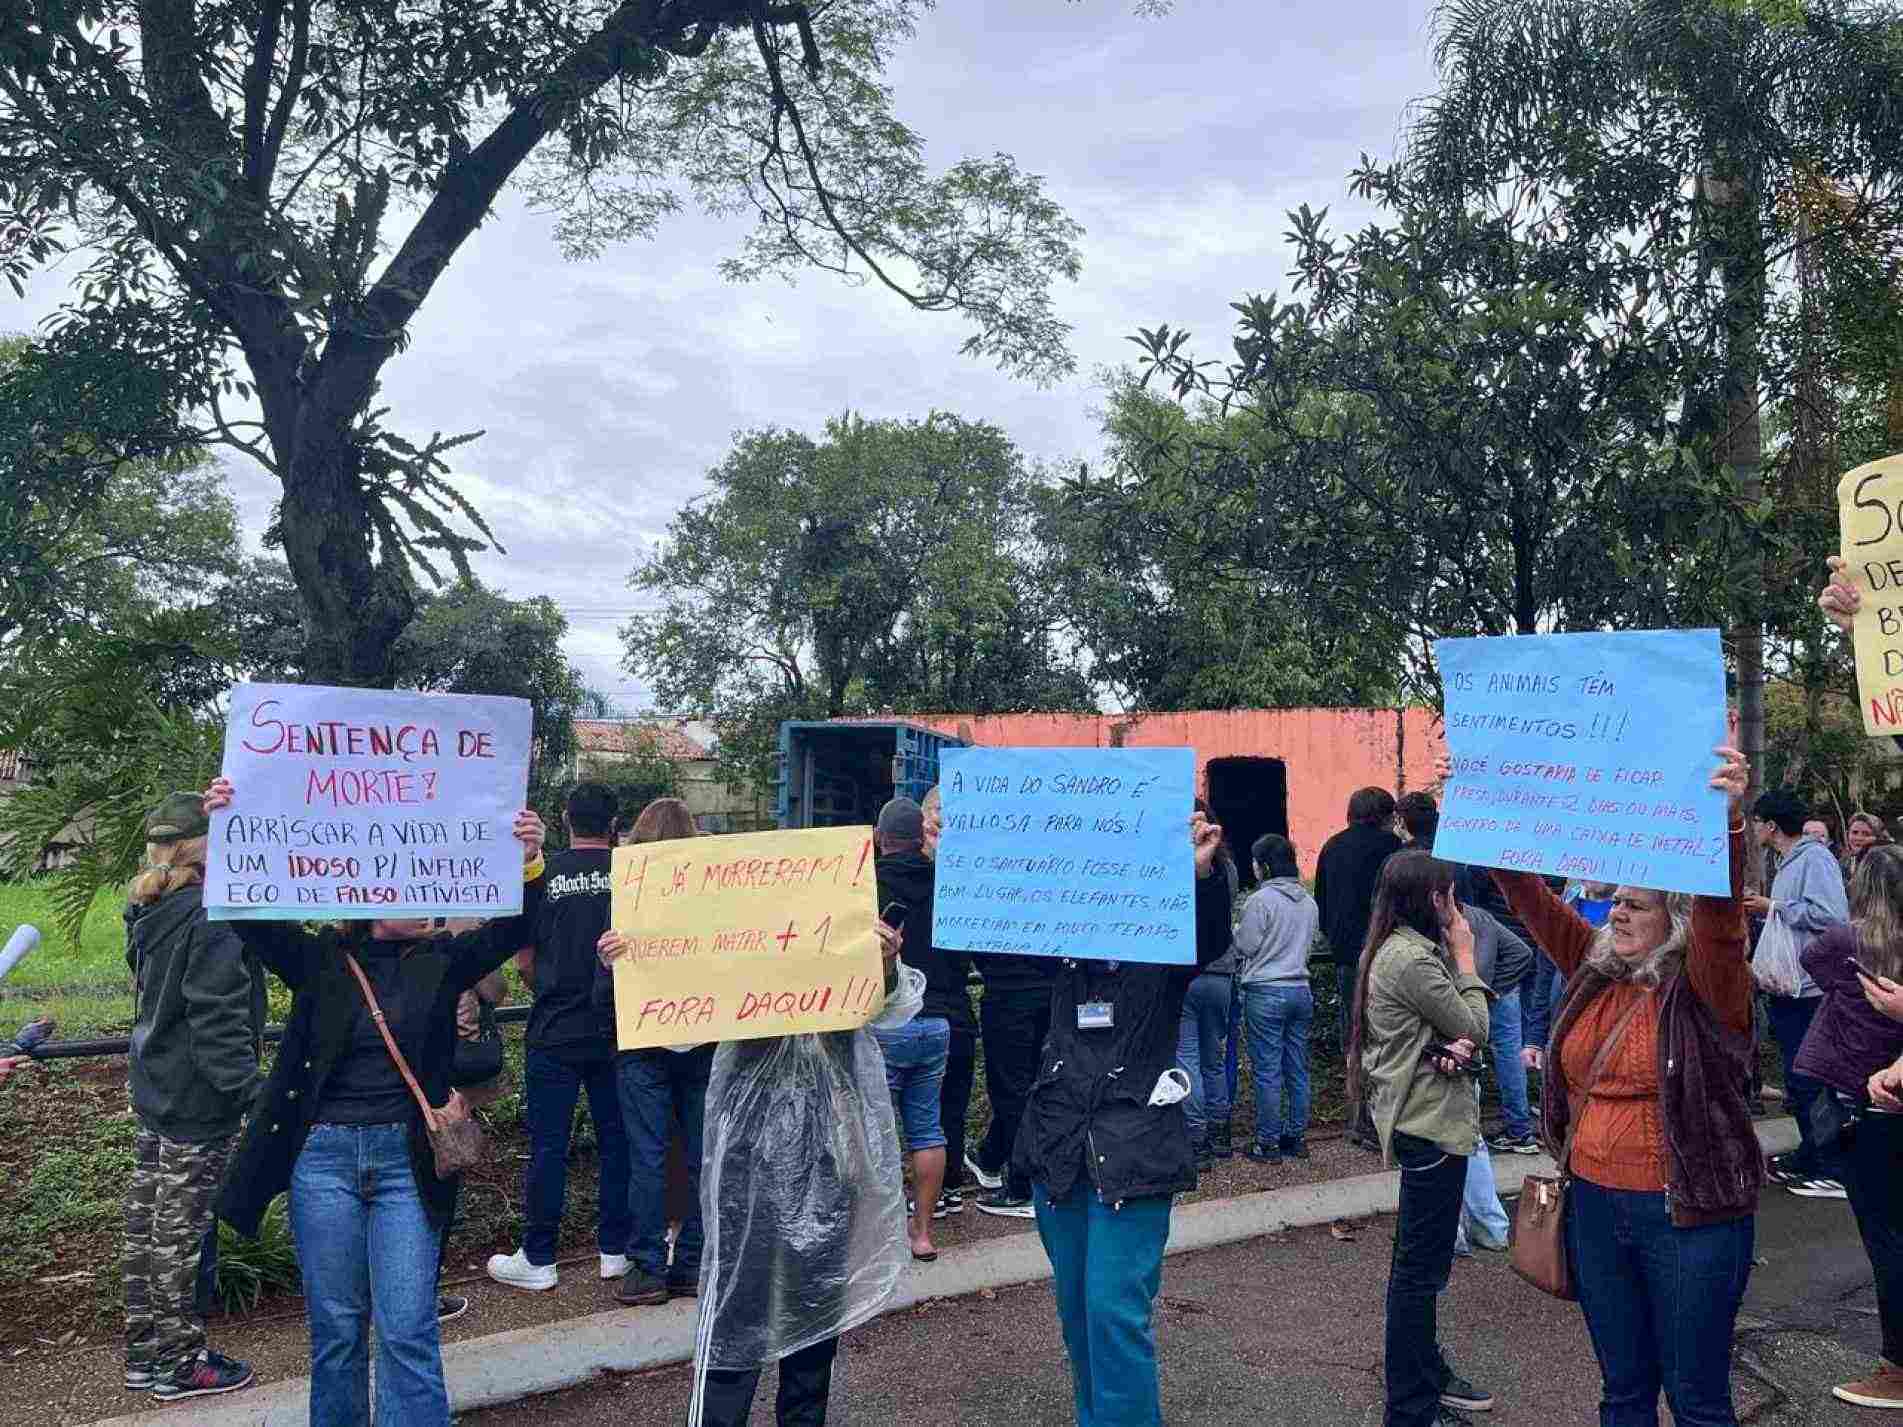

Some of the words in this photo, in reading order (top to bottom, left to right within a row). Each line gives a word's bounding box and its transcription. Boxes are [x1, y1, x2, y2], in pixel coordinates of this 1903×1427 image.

[1853, 473, 1903, 546] S
[1878, 606, 1903, 636] B
[1454, 673, 1473, 691] OS
[1488, 674, 1561, 695] ANIMAIS
[1576, 670, 1614, 696] TÊM
[242, 699, 440, 762] SENTENÇA
[458, 731, 496, 758] DE
[952, 769, 964, 794] A
[974, 775, 1009, 794] VIDA
[1019, 774, 1042, 795] DO
[1053, 773, 1122, 796] SANDRO
[1499, 760, 1576, 784] GOSTARIA
[1613, 767, 1664, 785] FICAR
[306, 768, 437, 806] MORTE?
[226, 814, 358, 847] ARRISCAR
[368, 822, 384, 847] A
[391, 819, 448, 845] VIDA
[463, 820, 494, 842] DE
[948, 813, 1032, 833] VALIOSA
[1044, 813, 1083, 833] PARA
[226, 854, 269, 875] UM
[287, 851, 360, 880] IDOSO
[411, 852, 487, 879] INFLAR
[944, 855, 967, 869] SE
[974, 856, 986, 869] O
[1080, 859, 1131, 877] FOSSE
[1499, 849, 1544, 867] FORA
[228, 882, 280, 904] EGO
[297, 884, 330, 904] DE
[336, 884, 397, 905] FALSO
[404, 881, 501, 906] ATIVISTA
[711, 929, 769, 952] MATAR
[635, 996, 716, 1032] FORA
